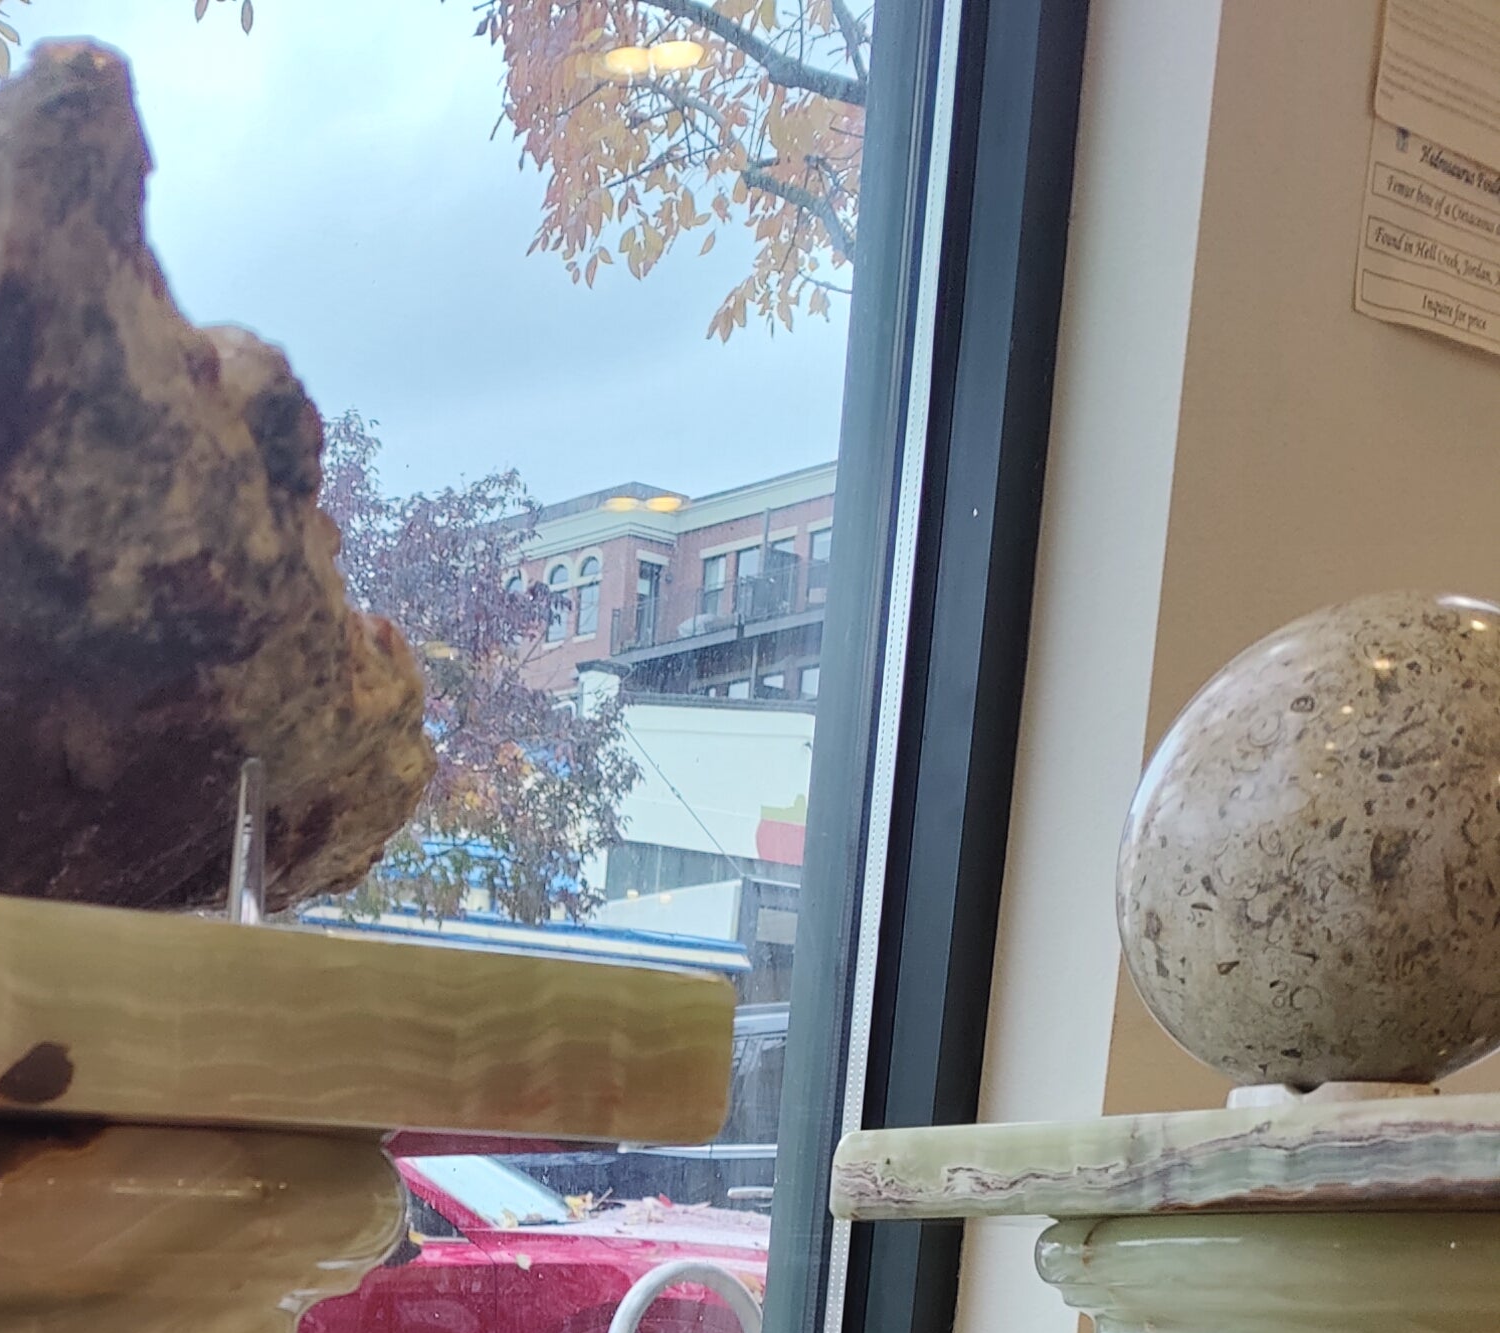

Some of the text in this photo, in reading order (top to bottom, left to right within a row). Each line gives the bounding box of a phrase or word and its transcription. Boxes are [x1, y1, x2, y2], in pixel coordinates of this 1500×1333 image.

[1375, 227, 1402, 251] Found
[1402, 238, 1412, 254] in
[1414, 236, 1437, 260] Hell
[1423, 295, 1486, 331] Inquire for price
